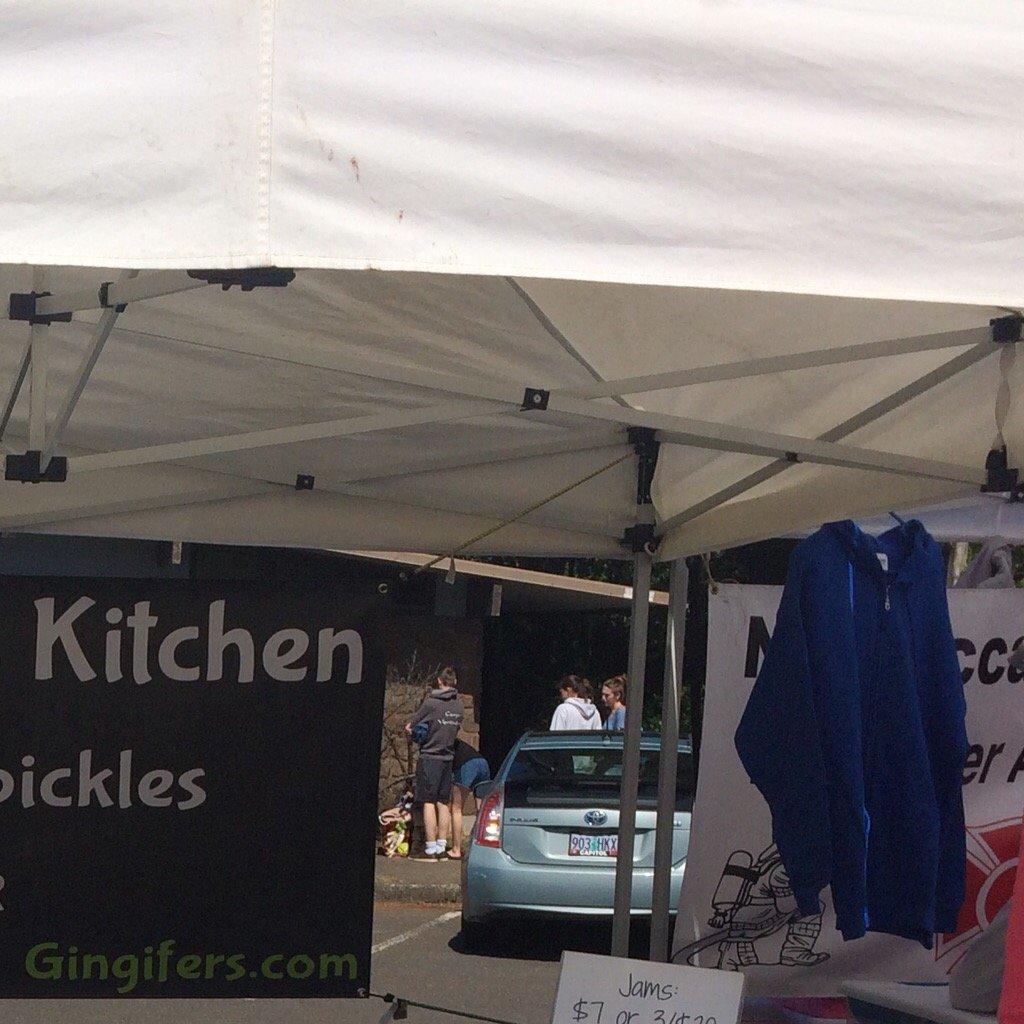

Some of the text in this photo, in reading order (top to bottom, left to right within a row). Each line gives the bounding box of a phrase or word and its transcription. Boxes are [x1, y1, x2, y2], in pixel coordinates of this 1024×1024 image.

[34, 595, 365, 686] Kitchen
[572, 837, 617, 851] 903 HKX
[26, 939, 358, 993] Gingifers.com
[619, 973, 678, 1000] Jams:
[573, 998, 604, 1024] $7
